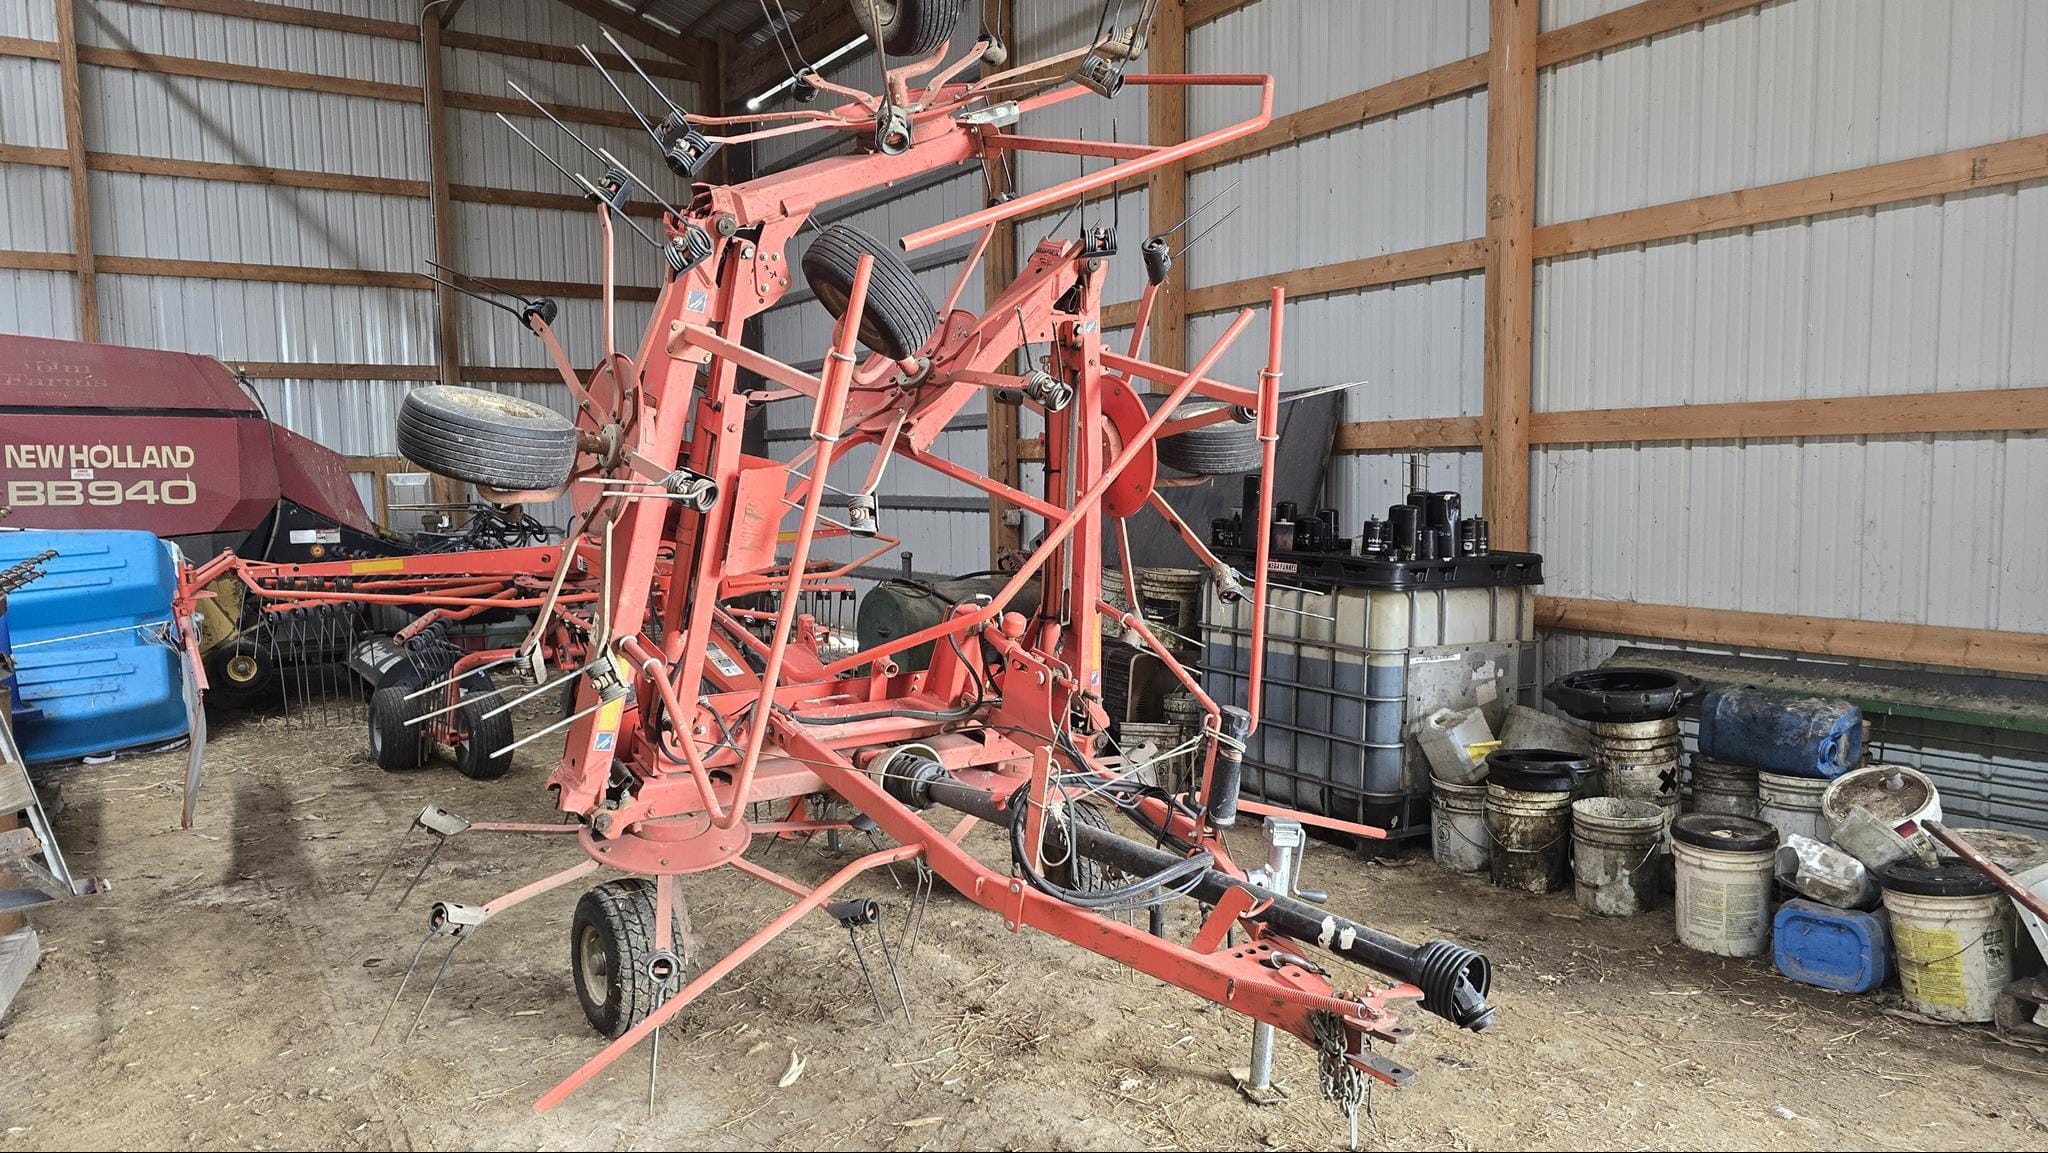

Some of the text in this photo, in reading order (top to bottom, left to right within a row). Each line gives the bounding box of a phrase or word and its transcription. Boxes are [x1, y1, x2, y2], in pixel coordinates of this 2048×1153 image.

[4, 444, 195, 469] NEW HOLLAND
[7, 480, 197, 507] BB940
